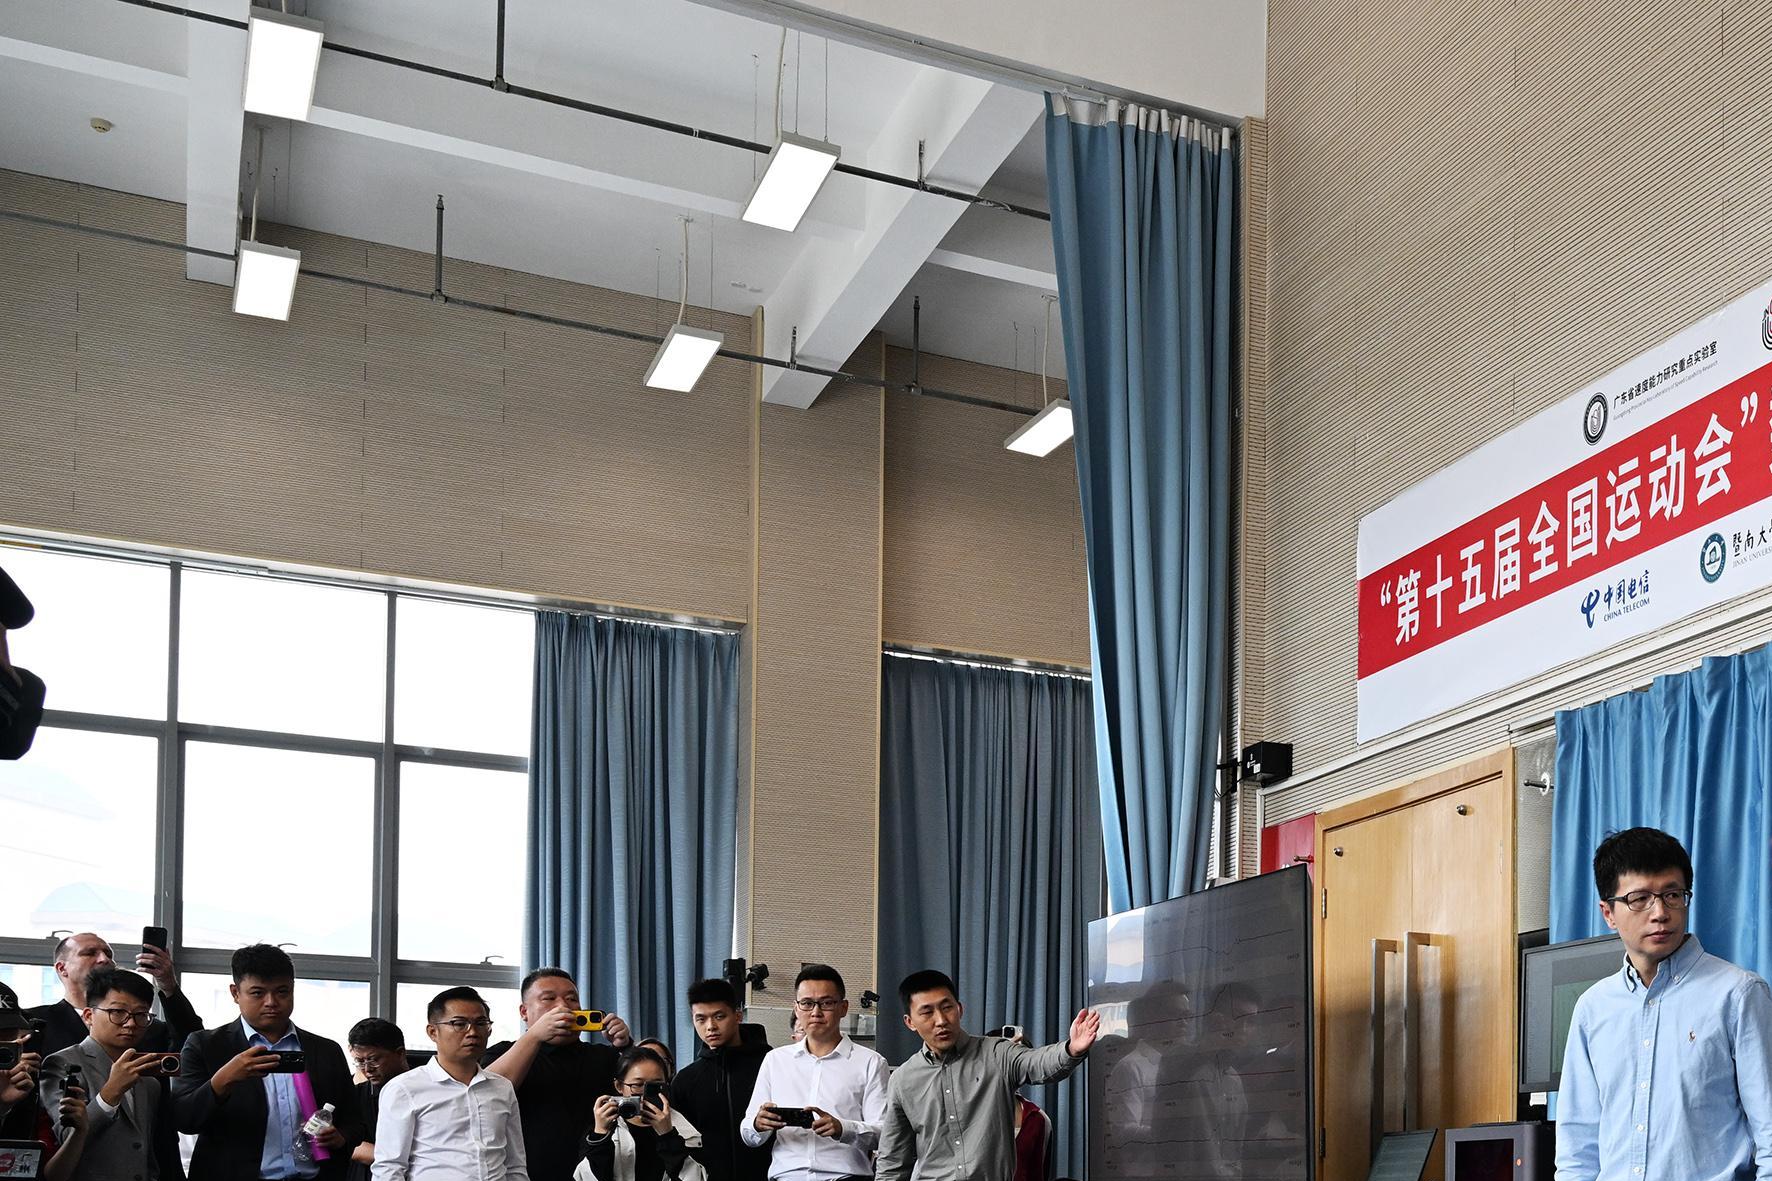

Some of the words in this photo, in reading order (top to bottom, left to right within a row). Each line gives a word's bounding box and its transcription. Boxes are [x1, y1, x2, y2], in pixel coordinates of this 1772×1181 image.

[1613, 341, 1718, 410] 广东省速度能力研究重点实验室
[1603, 569, 1650, 611] 中国电信
[1603, 608, 1621, 622] CHINA
[1623, 596, 1649, 614] TELECOM
